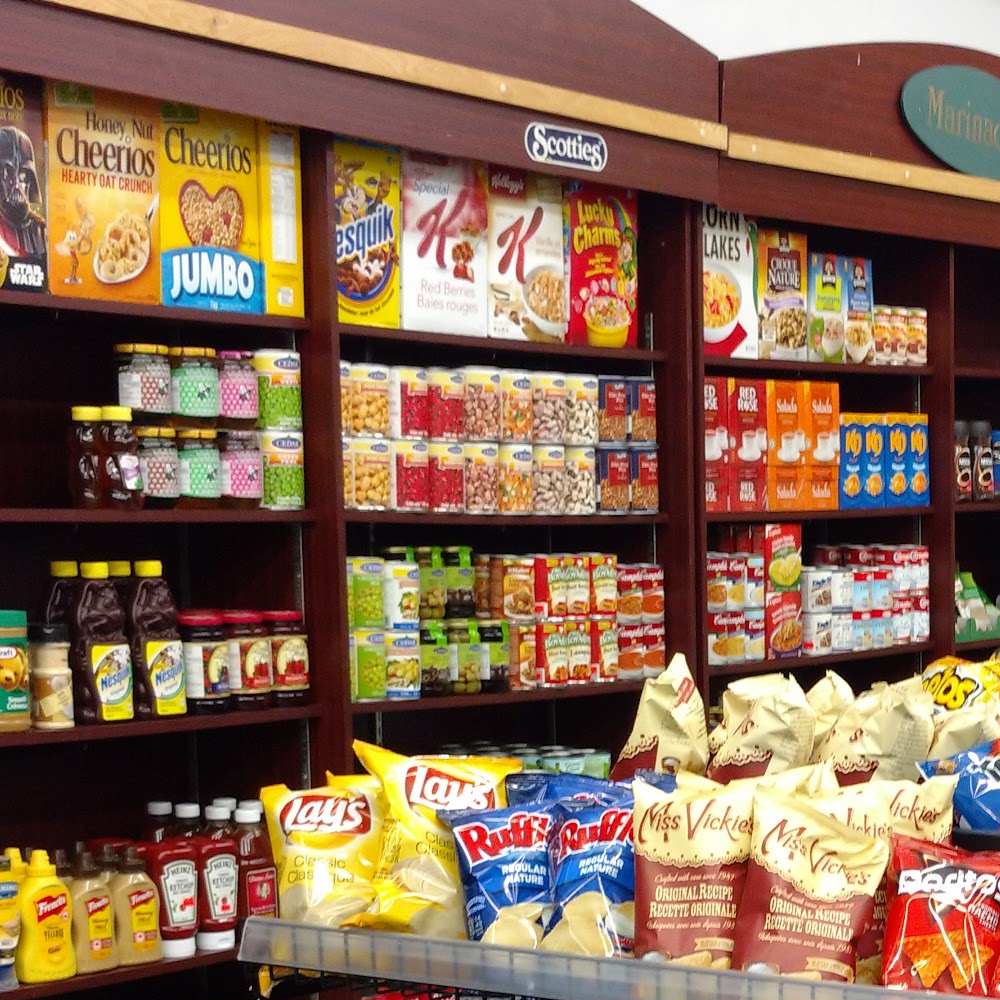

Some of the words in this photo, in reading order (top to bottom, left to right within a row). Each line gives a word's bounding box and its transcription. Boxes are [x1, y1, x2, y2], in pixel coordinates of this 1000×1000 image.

[86, 112, 126, 142] Honey
[56, 127, 155, 178] Cheerios
[164, 126, 251, 175] Cheerios
[532, 125, 601, 168] Scotties
[61, 168, 98, 187] HEARTY
[99, 172, 117, 189] OAT
[118, 175, 153, 194] CRUNCH
[413, 180, 449, 195] Special
[578, 199, 615, 227] Lucky
[573, 225, 622, 253] Charms
[703, 236, 741, 262] LAKES
[170, 251, 255, 300] JUMBO
[420, 279, 441, 294] Red
[444, 280, 475, 299] Berries
[417, 294, 444, 310] Baies
[446, 298, 479, 315] rouges
[739, 386, 756, 400] RED
[738, 398, 758, 412] ROSE
[776, 397, 797, 414] Salada
[812, 397, 832, 414] Salada
[408, 764, 496, 810] Lay's
[282, 796, 372, 836] Lay's
[639, 801, 681, 844] Miss
[686, 799, 753, 842] Vickie's
[455, 812, 551, 863] Ruff
[558, 809, 634, 856] Ruff
[171, 866, 191, 876] HEINZ
[213, 860, 232, 871] HEINZ
[501, 864, 547, 876] REGULAR
[578, 856, 624, 870] REGULAR
[506, 874, 544, 886] NATURE
[655, 886, 699, 901] ORIGINAL
[700, 883, 733, 901] RECIPE
[649, 903, 689, 918] RECETTE
[691, 903, 736, 918] ORIGINALE
[769, 895, 814, 919] ORIGINAL
[764, 913, 803, 931] RECETTE
